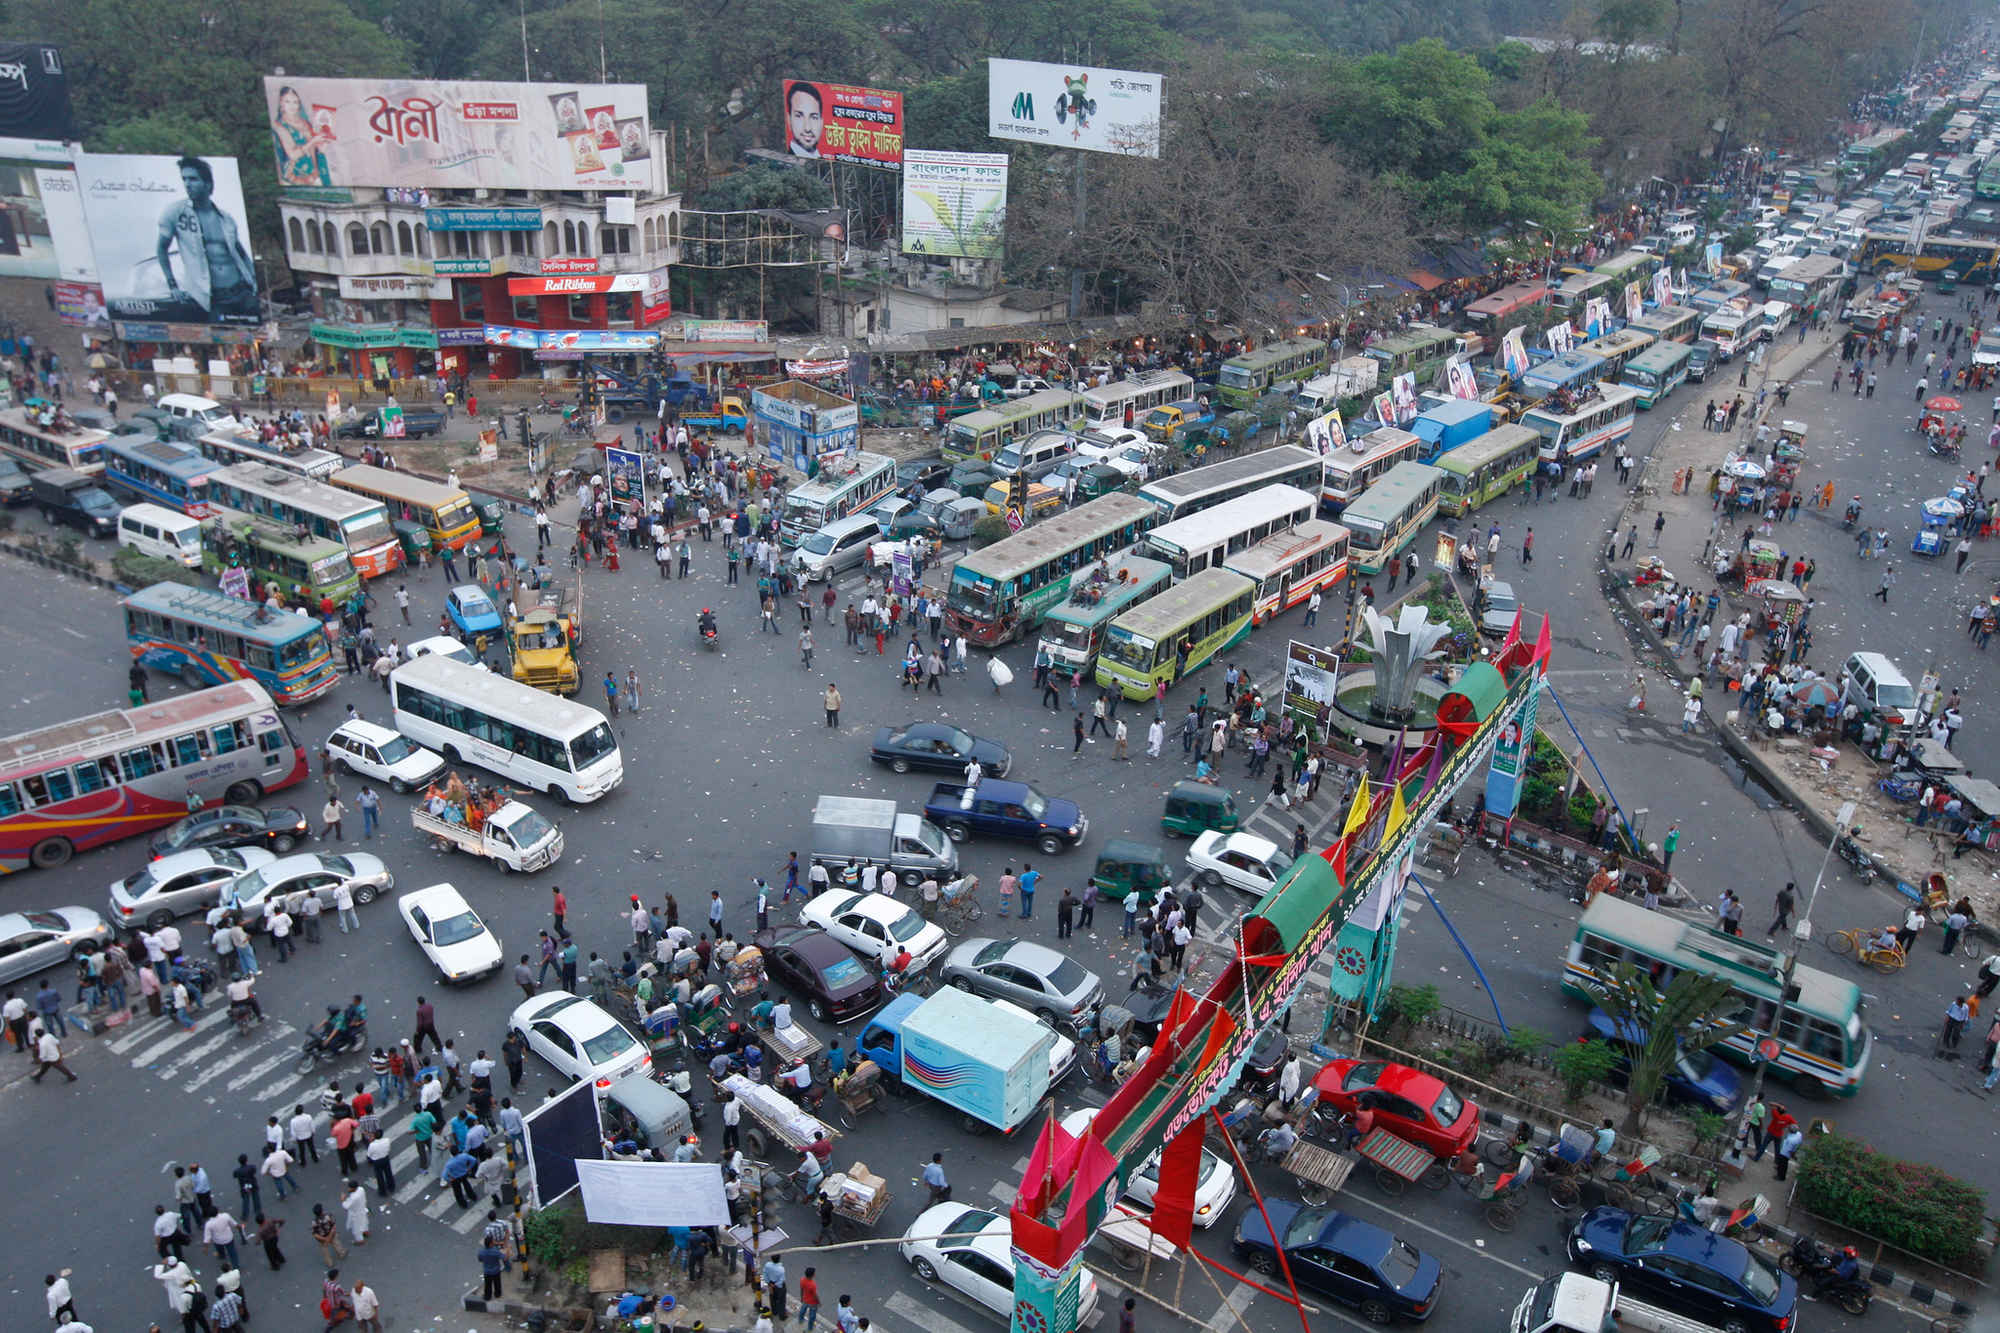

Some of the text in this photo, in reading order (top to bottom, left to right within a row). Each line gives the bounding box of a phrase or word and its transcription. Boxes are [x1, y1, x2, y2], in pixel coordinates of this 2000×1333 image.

[824, 120, 901, 155] ডক্টর তুহিন মালিক
[911, 163, 969, 177] বাংলাদেশ
[545, 278, 596, 291] Red Ribbon
[1310, 920, 1334, 956] খান
